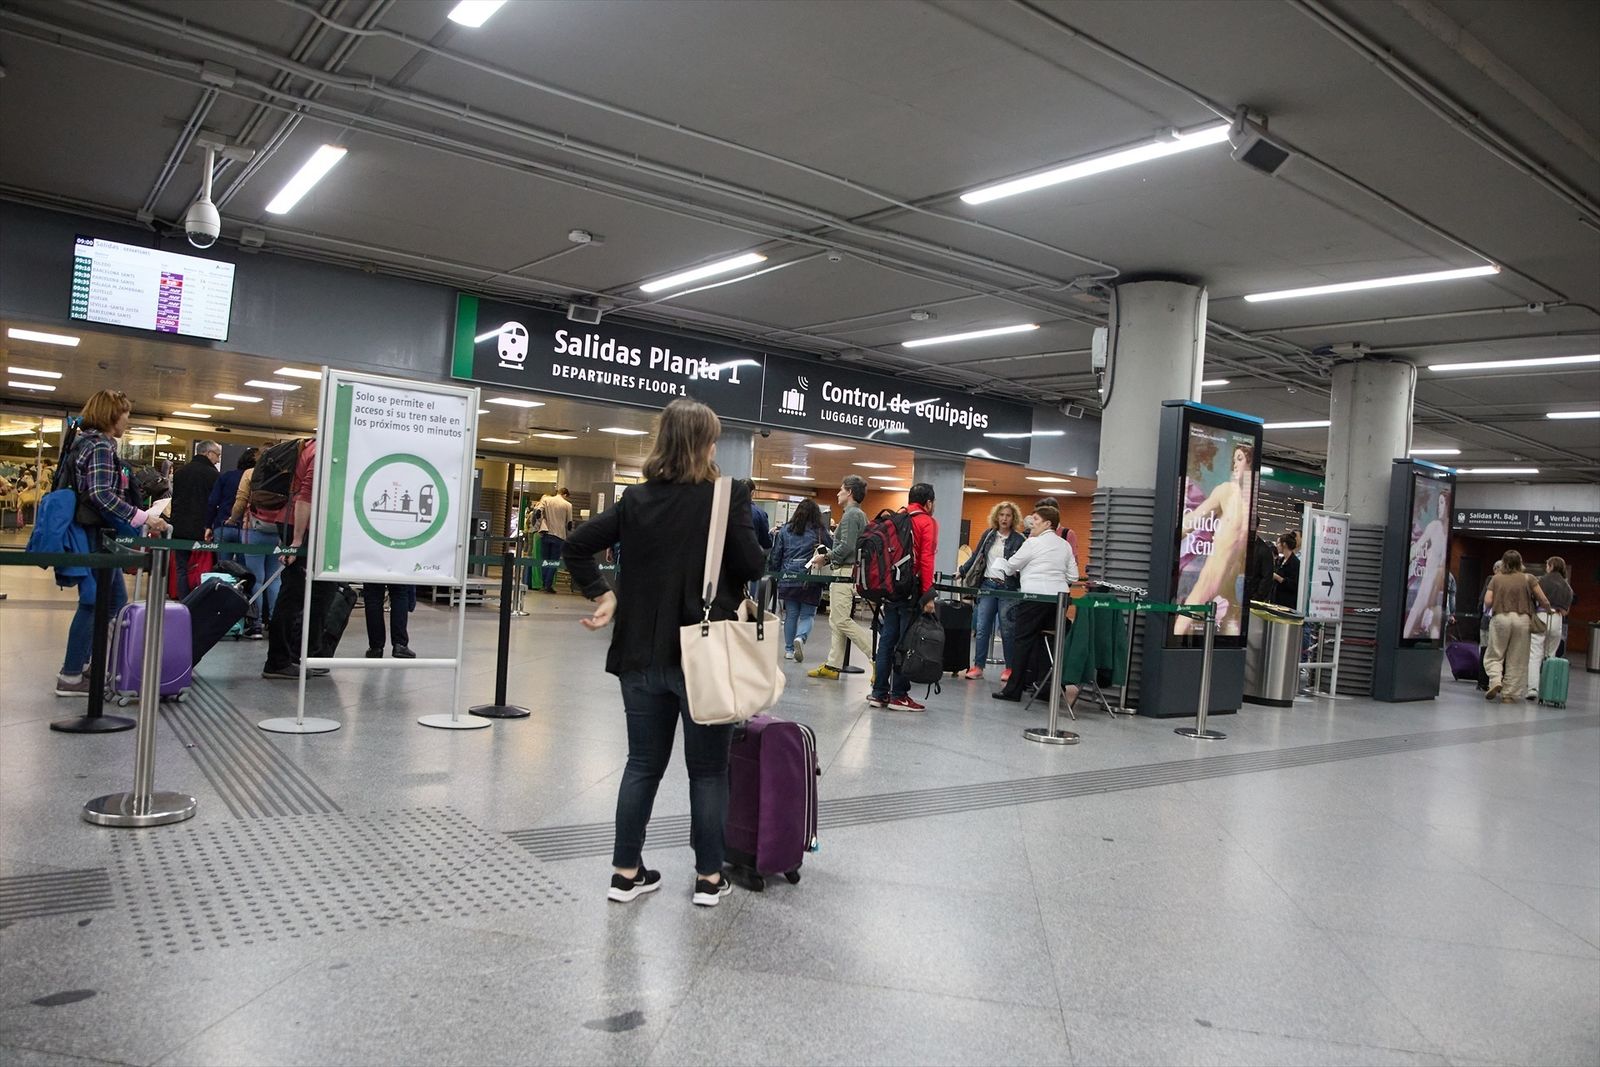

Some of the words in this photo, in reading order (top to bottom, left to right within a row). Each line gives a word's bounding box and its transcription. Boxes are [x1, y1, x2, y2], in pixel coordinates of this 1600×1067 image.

[76, 238, 94, 246] 09:00
[96, 242, 119, 250] Salidas
[554, 330, 641, 366] Salidas
[650, 346, 720, 380] Planta
[728, 364, 740, 384] 1
[552, 364, 635, 388] DEPARTURES
[638, 378, 676, 395] FLOOR
[680, 385, 686, 396] 1
[356, 391, 375, 402] Solo
[390, 397, 424, 408] permite
[427, 401, 435, 410] el
[822, 381, 887, 411] Control
[891, 394, 911, 414] de
[916, 402, 988, 430] equipajes
[355, 405, 384, 416] acceso
[387, 408, 394, 417] si
[409, 412, 427, 422] tren
[430, 414, 447, 424] sale
[821, 409, 864, 426] LUGGAGE
[868, 417, 905, 430] CONTROL
[354, 417, 367, 426] los
[370, 418, 410, 432] próximos
[413, 424, 424, 433] 90
[427, 426, 462, 438] minutos
[480, 521, 487, 530] 3
[1182, 508, 1222, 532] Guido
[1186, 533, 1215, 556] Reni
